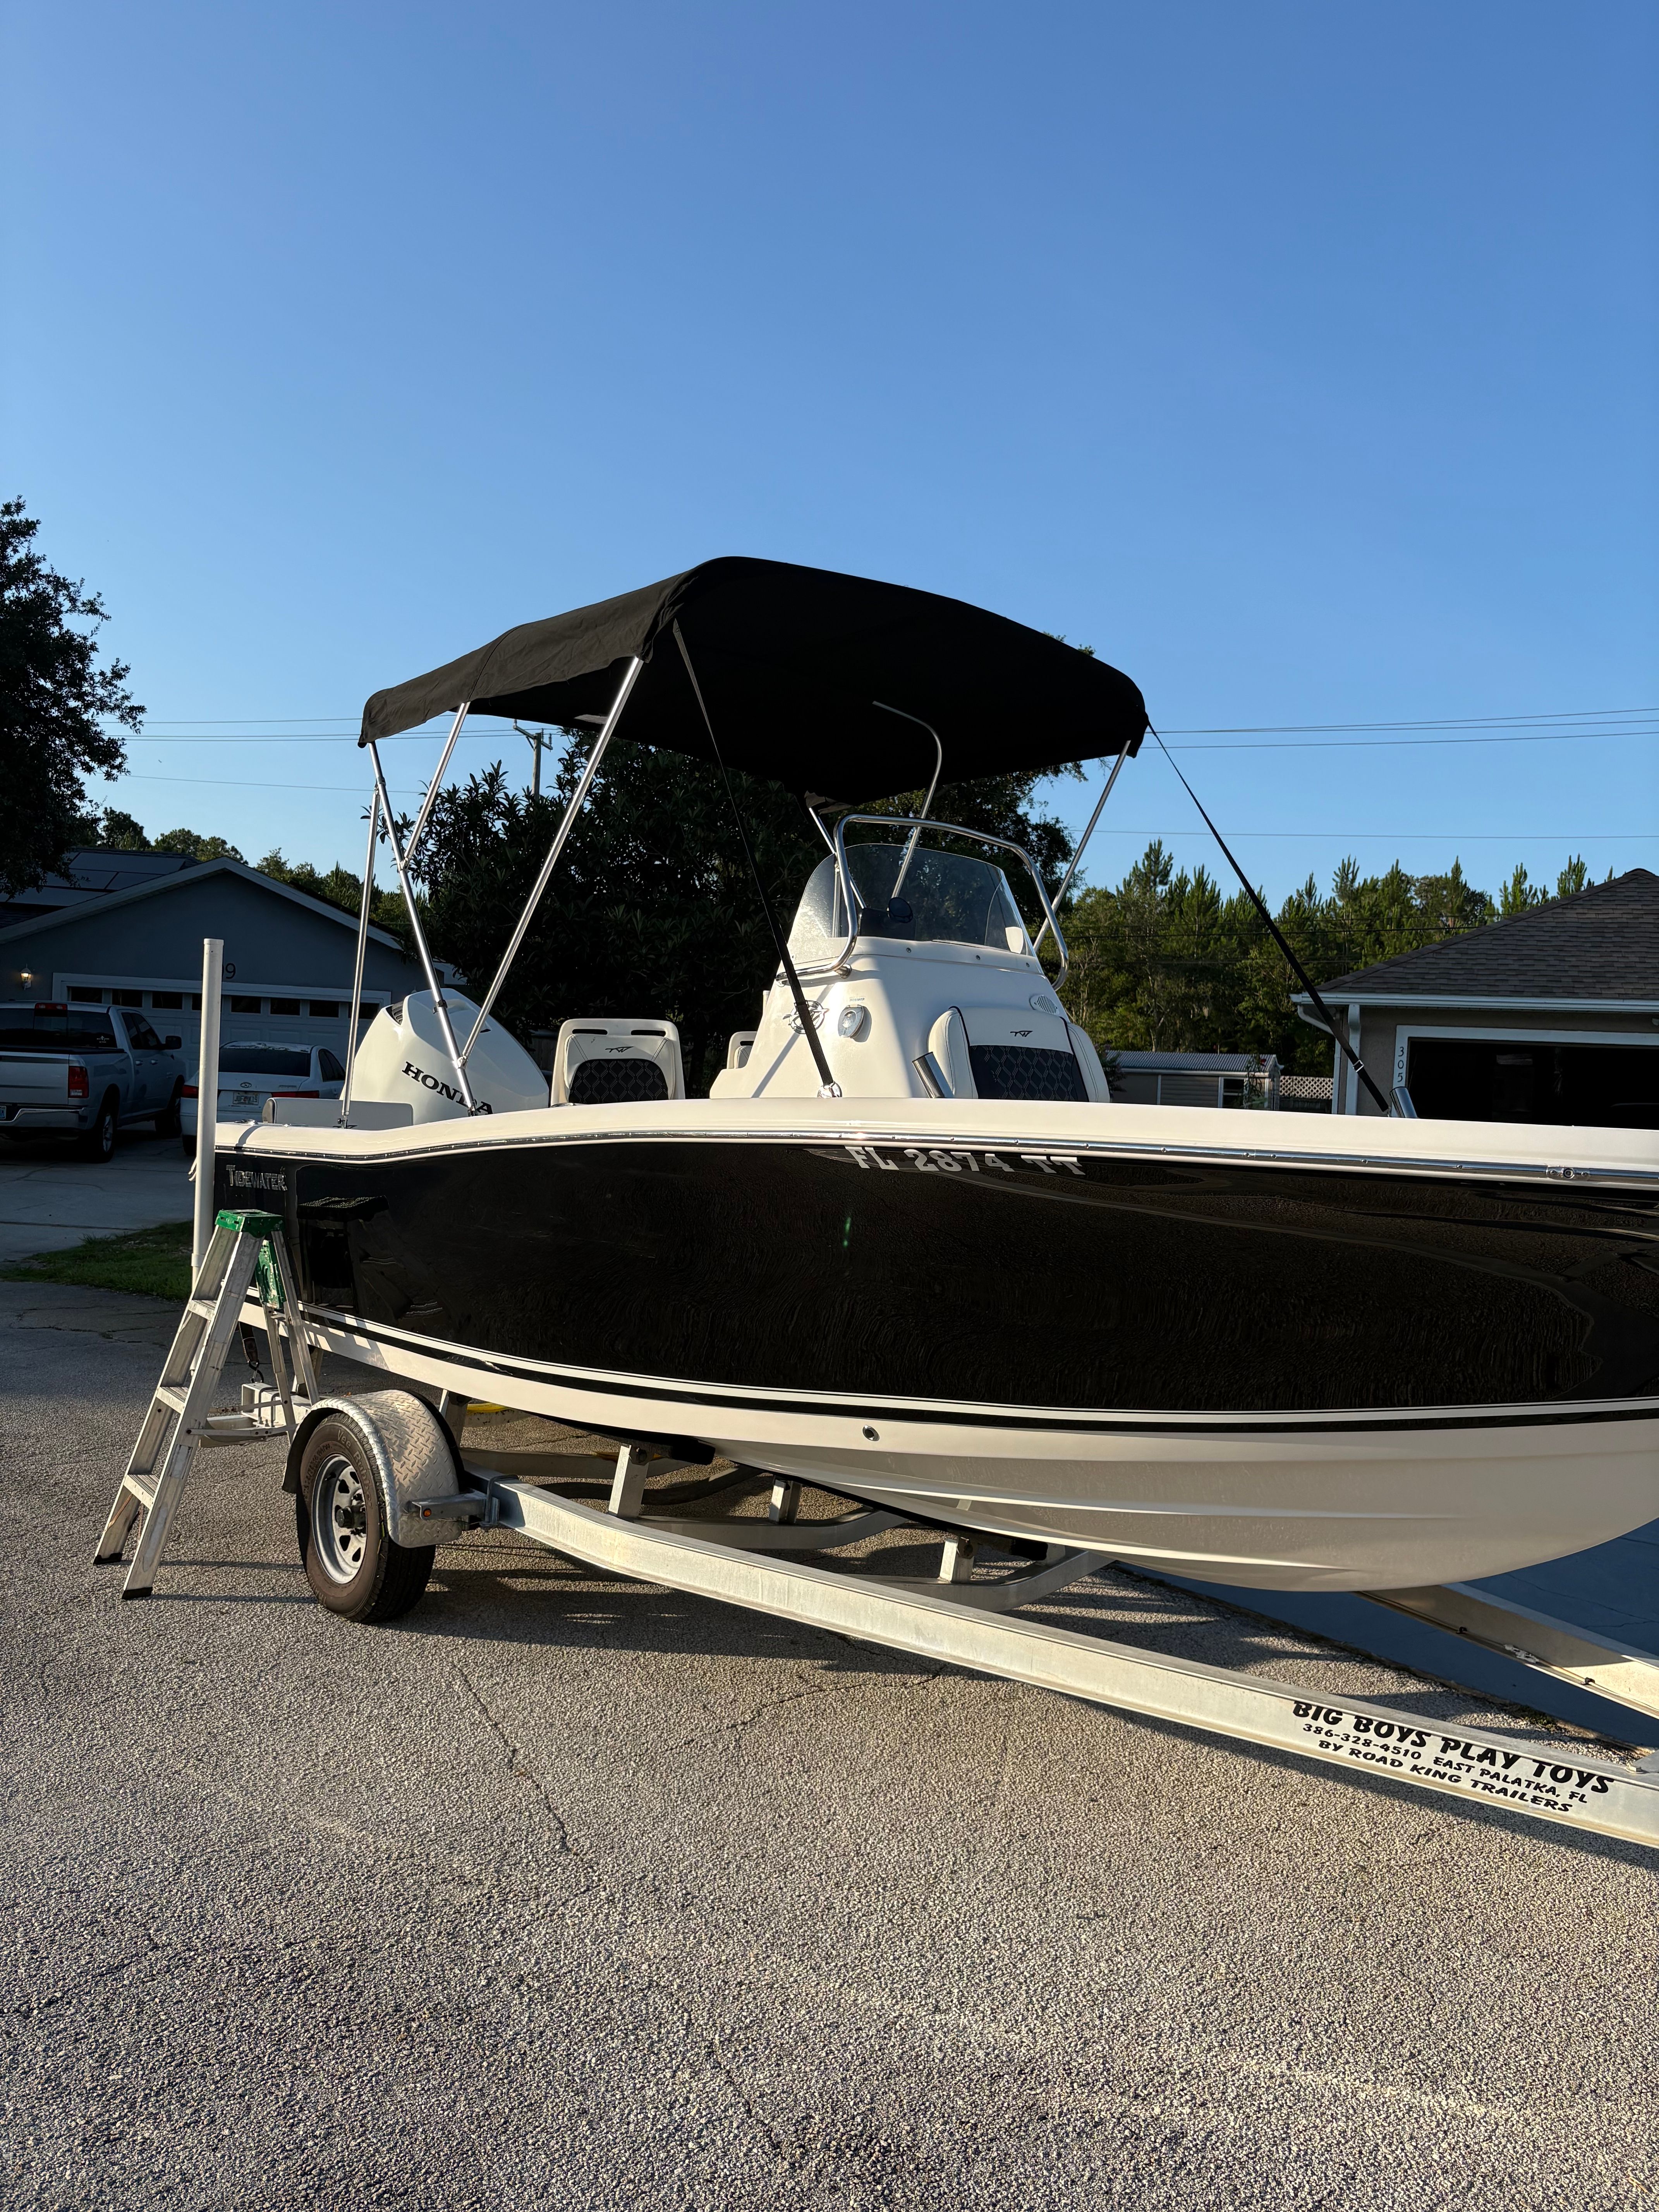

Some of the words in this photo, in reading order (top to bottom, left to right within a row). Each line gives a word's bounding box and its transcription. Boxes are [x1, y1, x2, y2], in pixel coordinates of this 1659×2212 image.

[222, 963, 236, 979] 9
[845, 1145, 900, 1170] FL
[903, 1149, 1015, 1173] 2874
[1020, 1155, 1086, 1175] TT
[337, 1429, 351, 1449] Vee
[1293, 1700, 1343, 1725] BIG
[1353, 1715, 1432, 1748] BOYS
[1439, 1736, 1522, 1770] PLAY
[1532, 1759, 1614, 1793] TOYS
[1302, 1723, 1422, 1760] 386-328-4510
[1433, 1756, 1475, 1773] EAST
[1479, 1768, 1561, 1798] PALATKA,
[1568, 1791, 1588, 1803] FL
[1318, 1740, 1344, 1752] BY
[1348, 1747, 1403, 1767] ROAD
[1409, 1764, 1462, 1783] KING
[1470, 1779, 1573, 1812] TRAILERS
